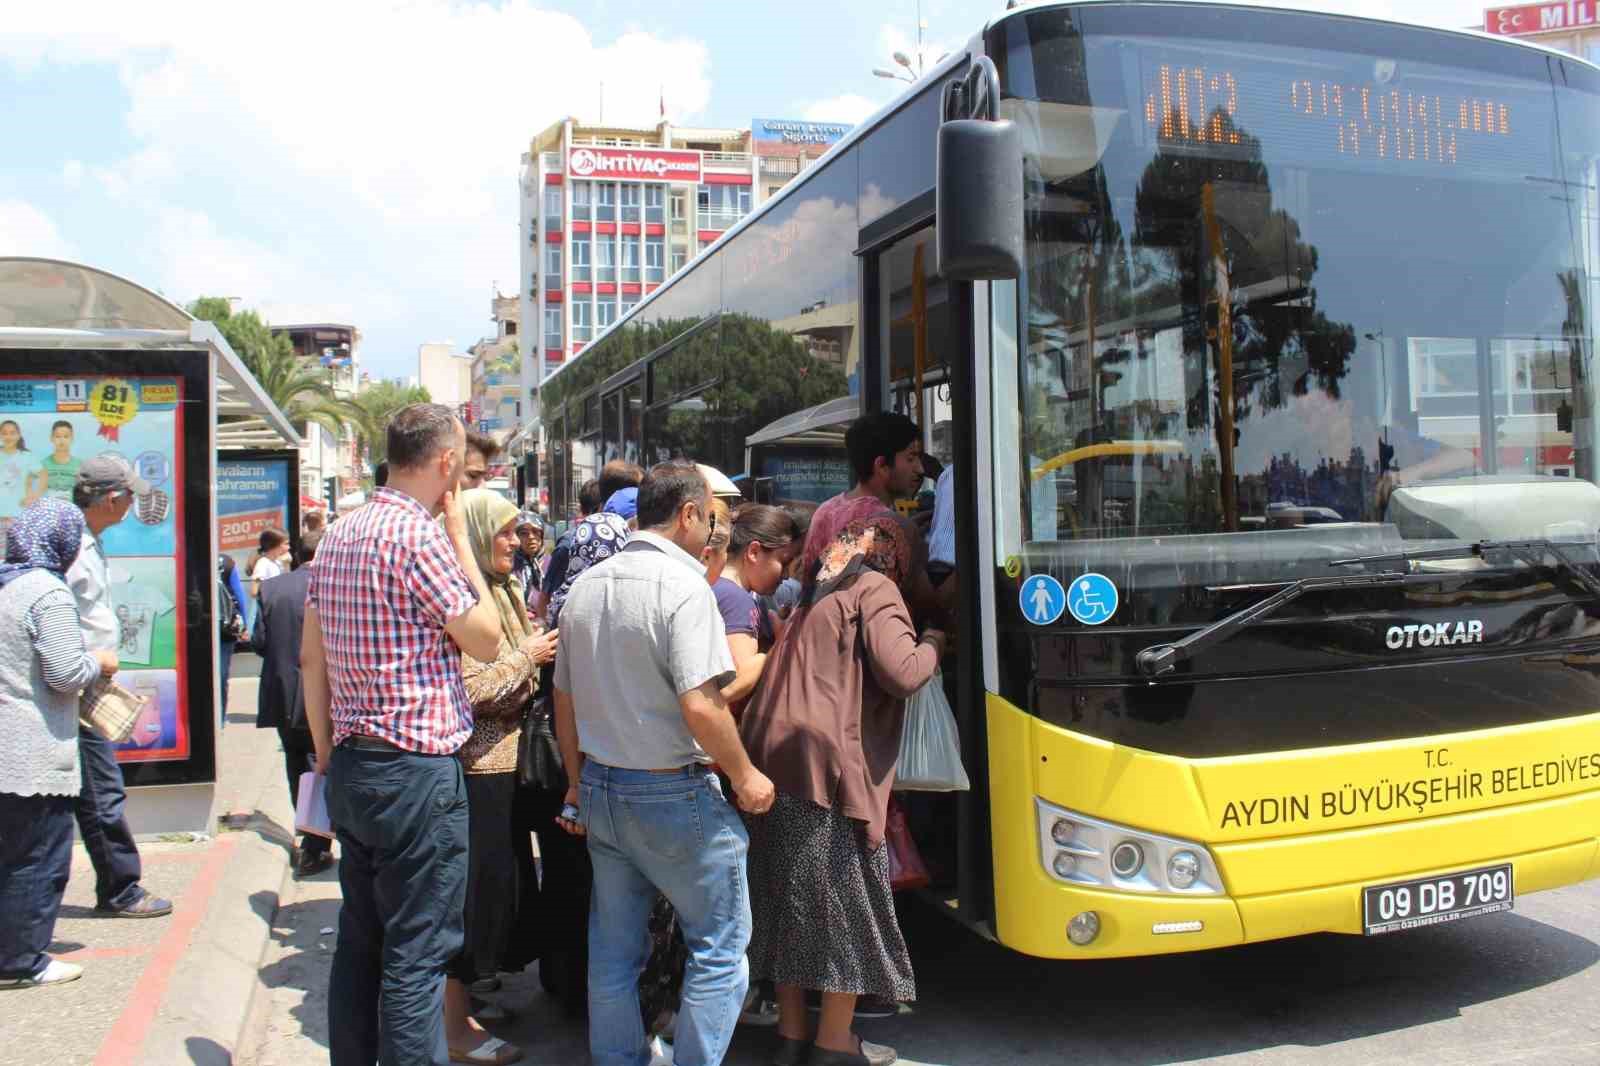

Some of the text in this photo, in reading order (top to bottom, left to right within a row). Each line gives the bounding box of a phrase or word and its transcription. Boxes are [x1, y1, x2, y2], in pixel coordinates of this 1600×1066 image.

[1541, 0, 1600, 28] MİL
[596, 151, 667, 176] İHTİYAÇ
[63, 384, 80, 398] 11
[102, 384, 128, 402] 81
[223, 522, 250, 537] 200
[1385, 620, 1483, 649] OTOKAR
[1424, 748, 1453, 768] T.C.
[1221, 794, 1309, 829] AYDIN
[1322, 769, 1483, 818] BÜYÜKŞEHİR
[1379, 871, 1507, 920] 09 DB 709
